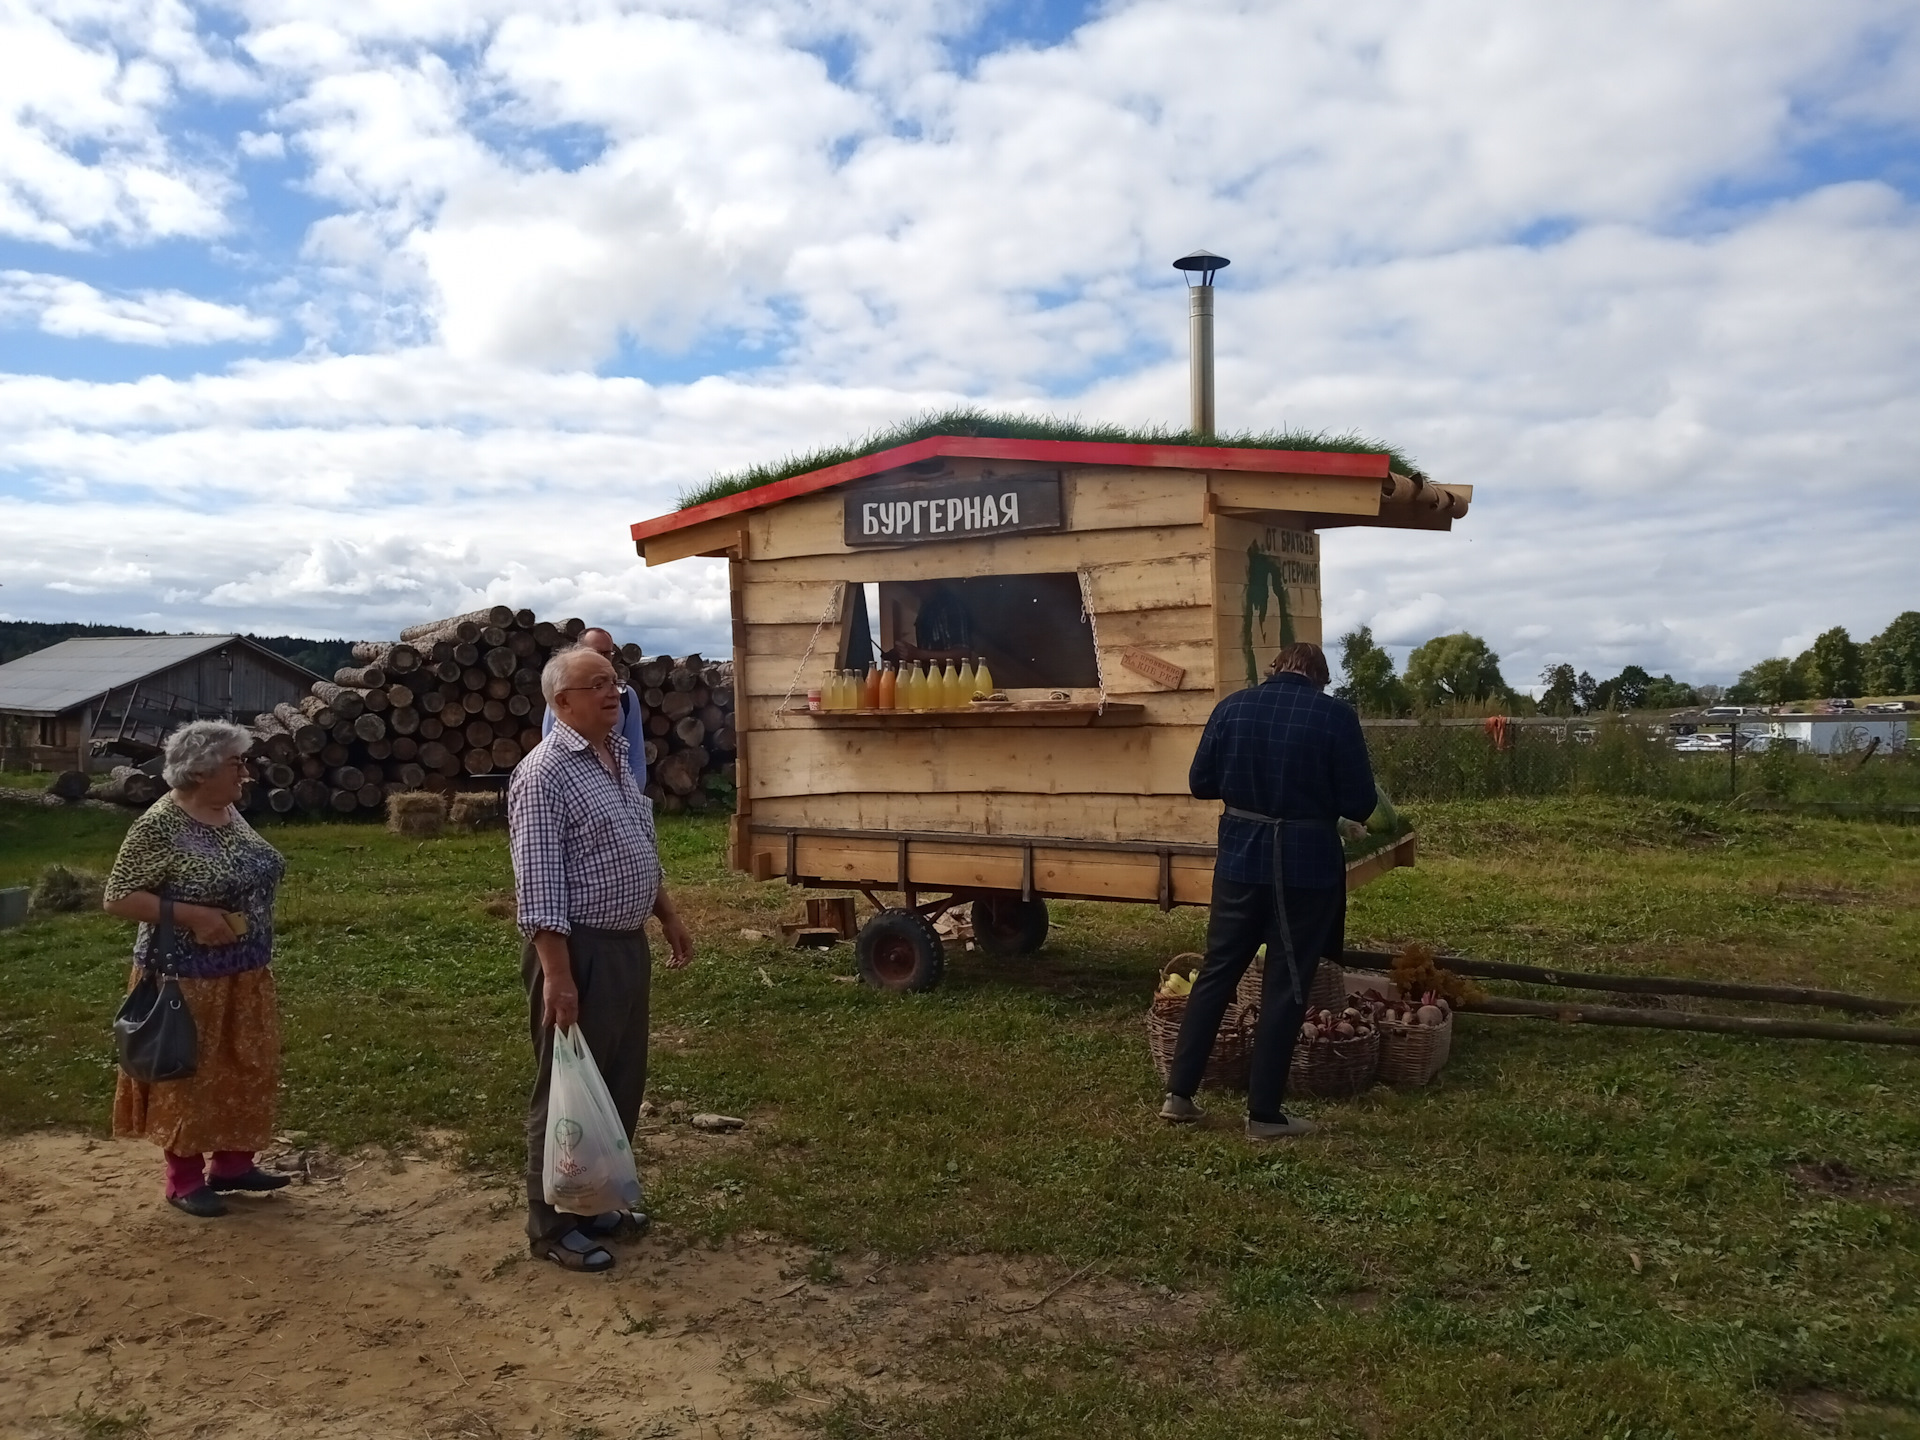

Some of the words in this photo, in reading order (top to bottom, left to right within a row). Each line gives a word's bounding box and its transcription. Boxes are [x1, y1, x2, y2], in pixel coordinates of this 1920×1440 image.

[862, 492, 1020, 535] БУРГЕРНАЯ
[1266, 527, 1276, 552] ОТ
[1281, 530, 1314, 555] БРАТЬЕВ
[1282, 560, 1318, 585] СТЕРЛИНГ
[1140, 654, 1180, 675] ПРОВЕРЕНО
